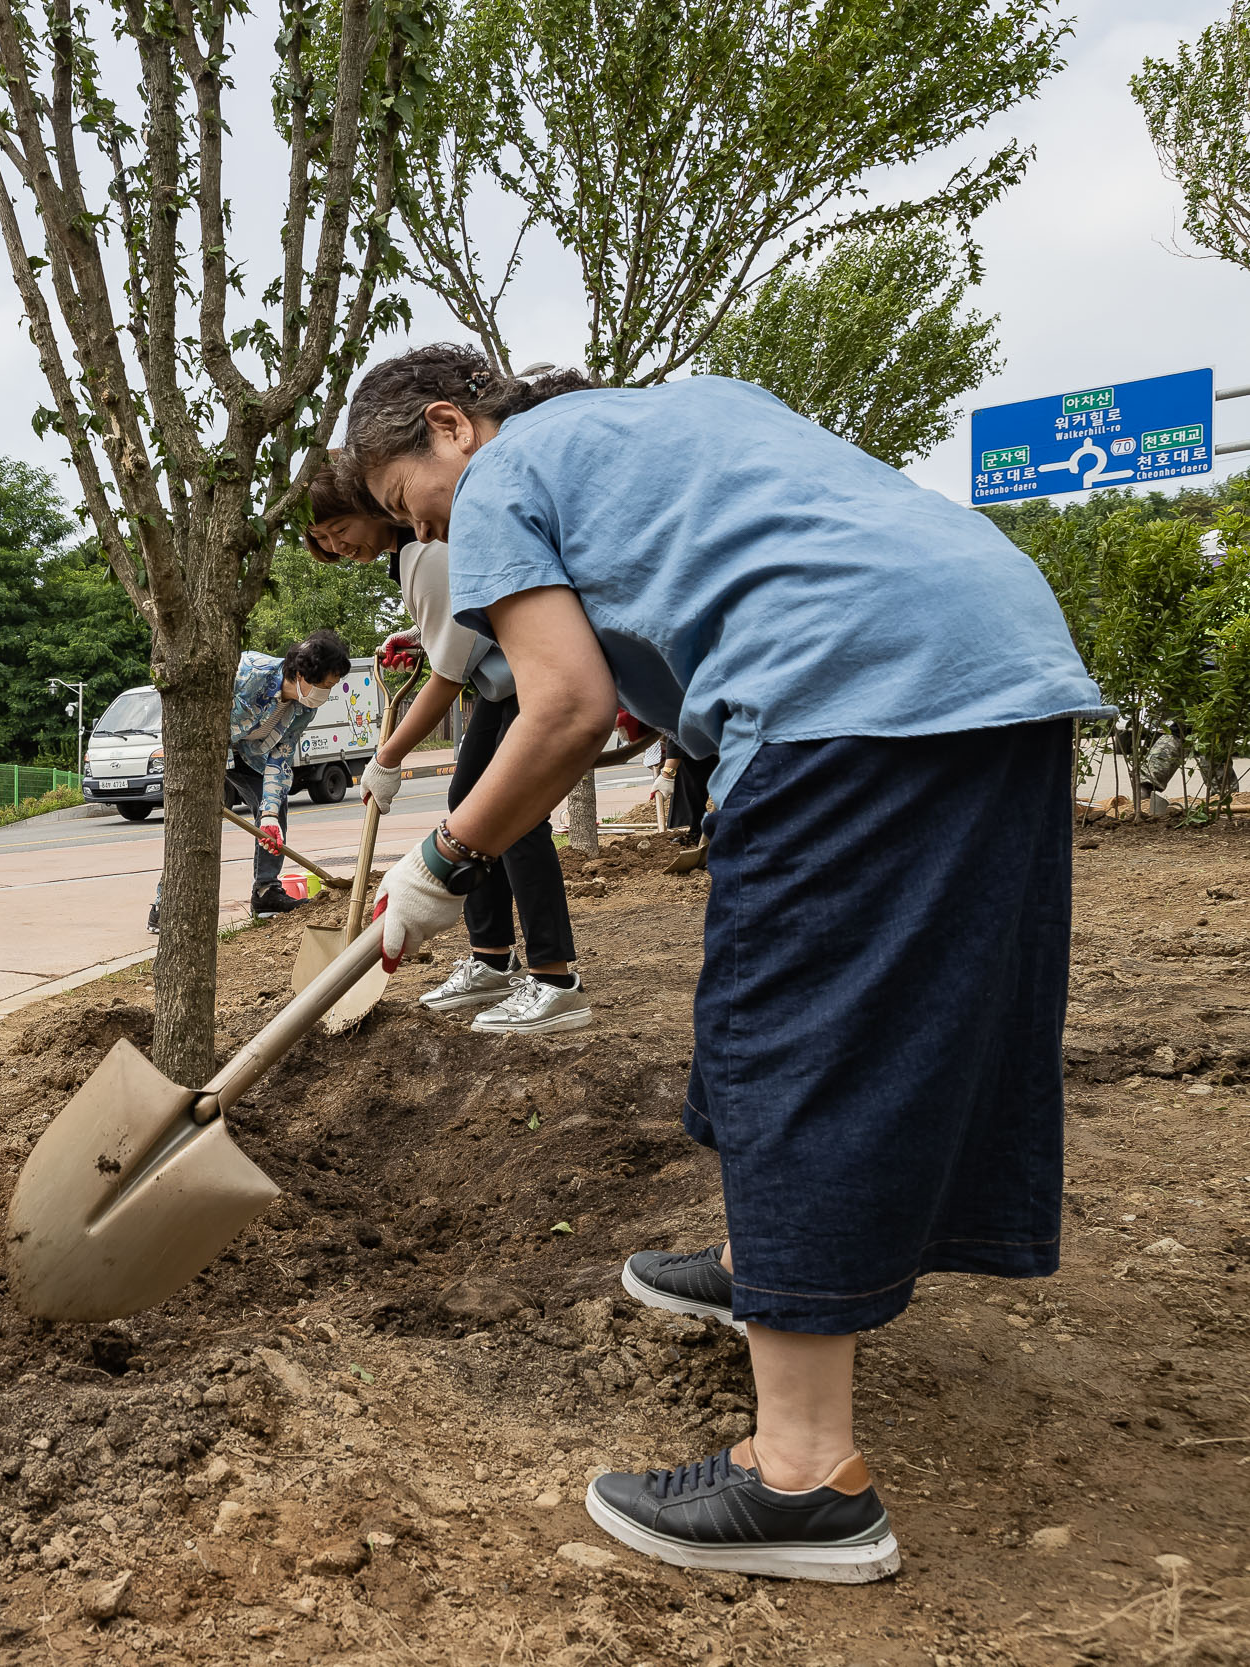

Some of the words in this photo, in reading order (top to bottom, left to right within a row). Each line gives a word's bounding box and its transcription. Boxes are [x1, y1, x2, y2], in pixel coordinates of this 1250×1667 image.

[1065, 391, 1111, 409] 아차산
[1055, 408, 1122, 430] 워커힐로
[1055, 424, 1121, 441] Walkerhill-ro
[1144, 428, 1201, 450] 천호대교
[1116, 441, 1131, 453] 70
[985, 448, 1027, 467] 군자역
[1137, 447, 1208, 471] 천호대로
[975, 466, 1037, 488] 천호대로
[1136, 463, 1209, 480] Cheonho-daero
[974, 482, 1037, 498] Cheonho-daero
